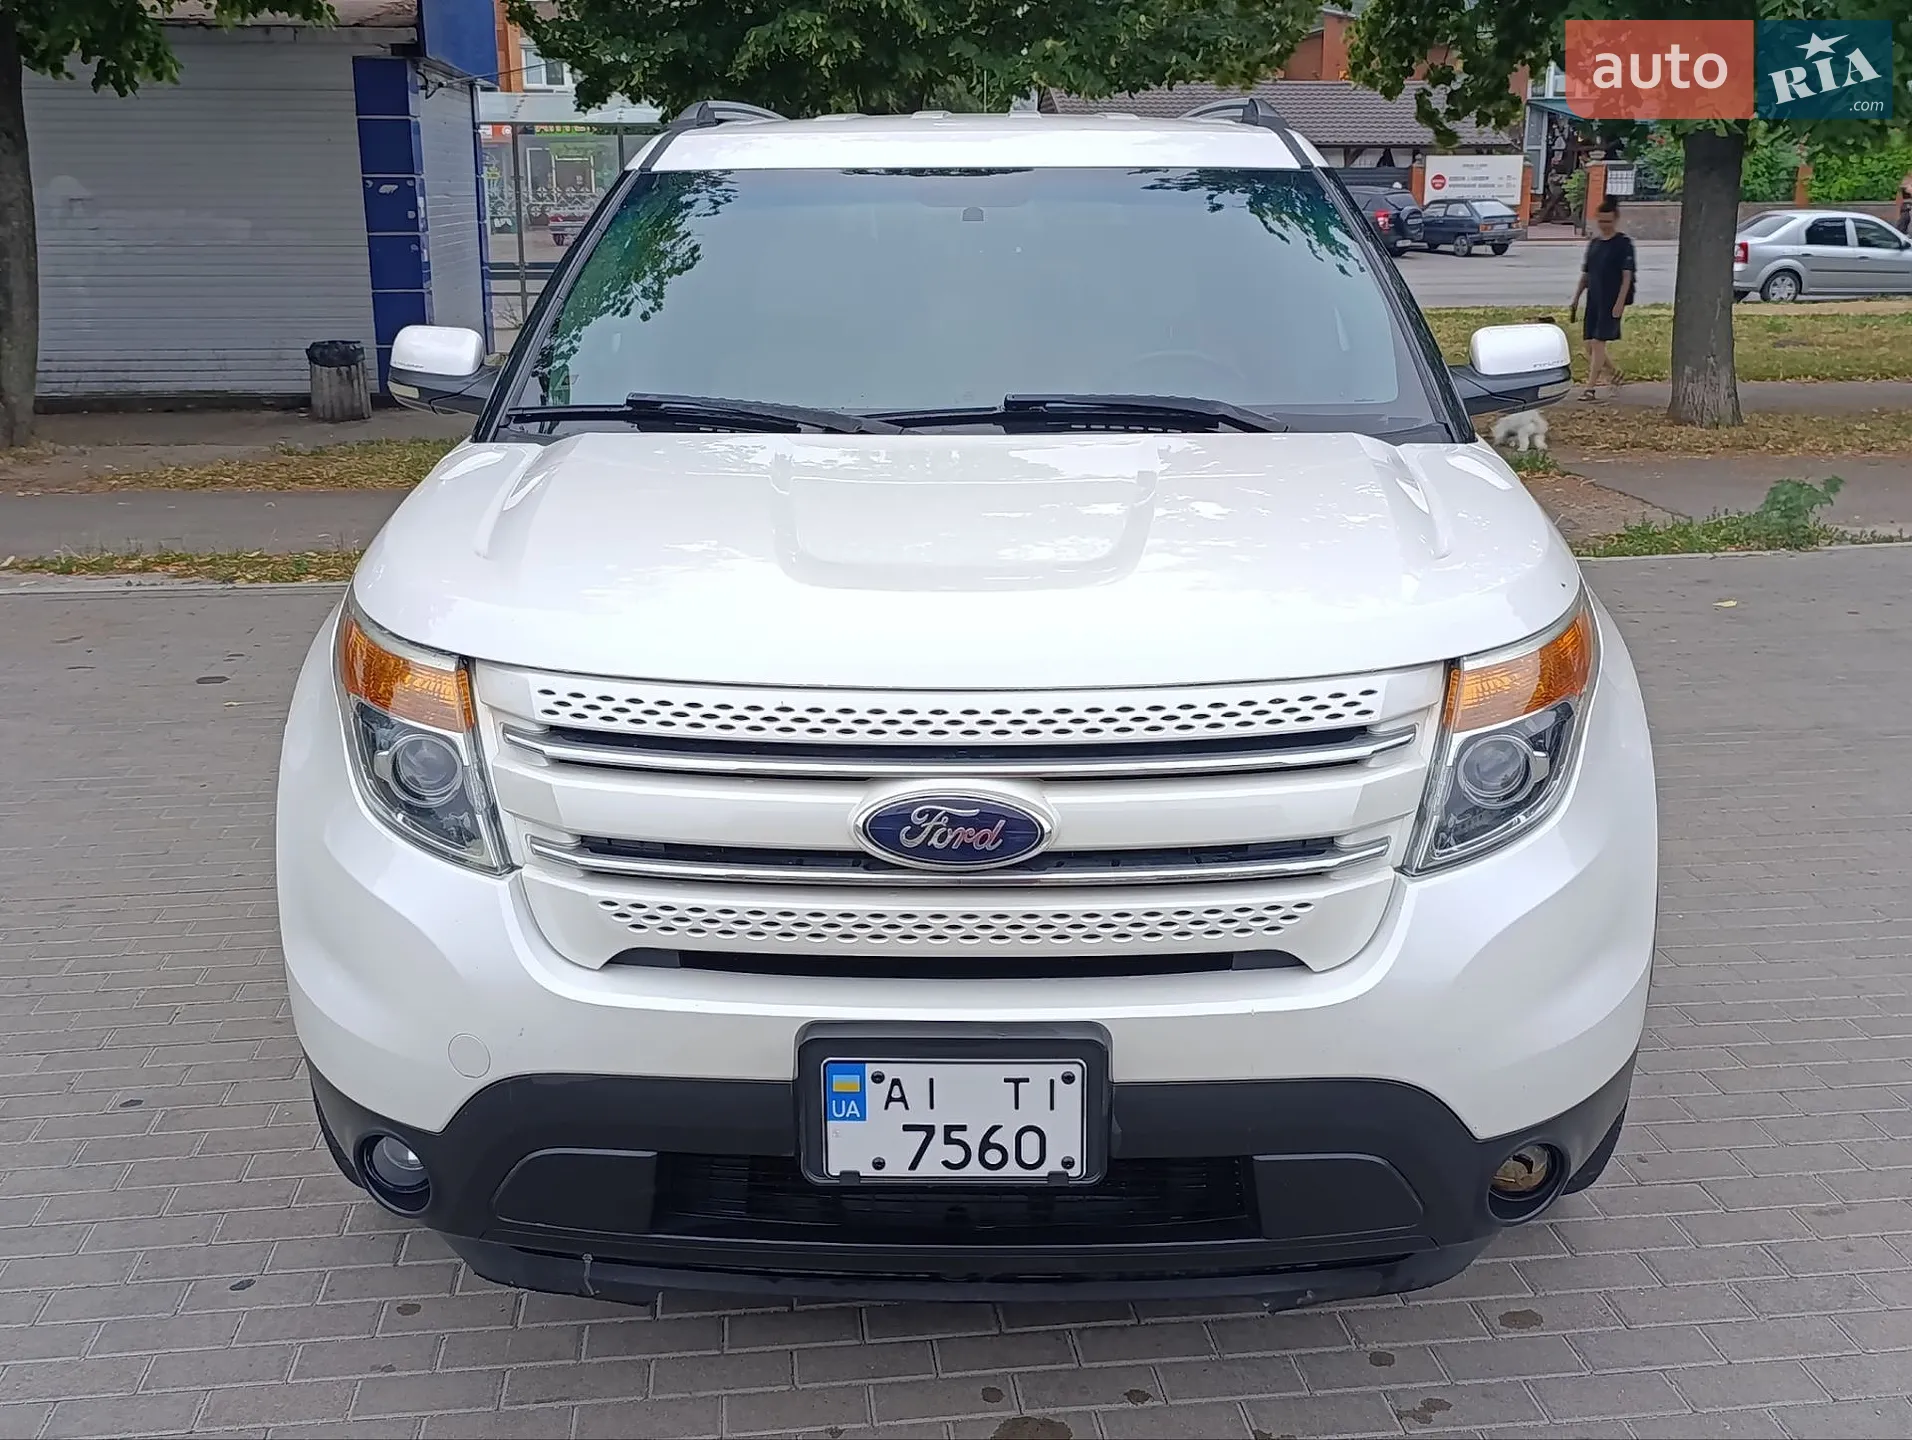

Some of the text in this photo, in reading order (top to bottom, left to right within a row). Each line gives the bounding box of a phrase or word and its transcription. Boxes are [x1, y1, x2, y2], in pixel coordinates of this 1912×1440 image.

[900, 805, 1006, 850] Ford
[831, 1099, 860, 1118] UA
[884, 1077, 1055, 1111] AI TI
[902, 1124, 1047, 1171] 7560
